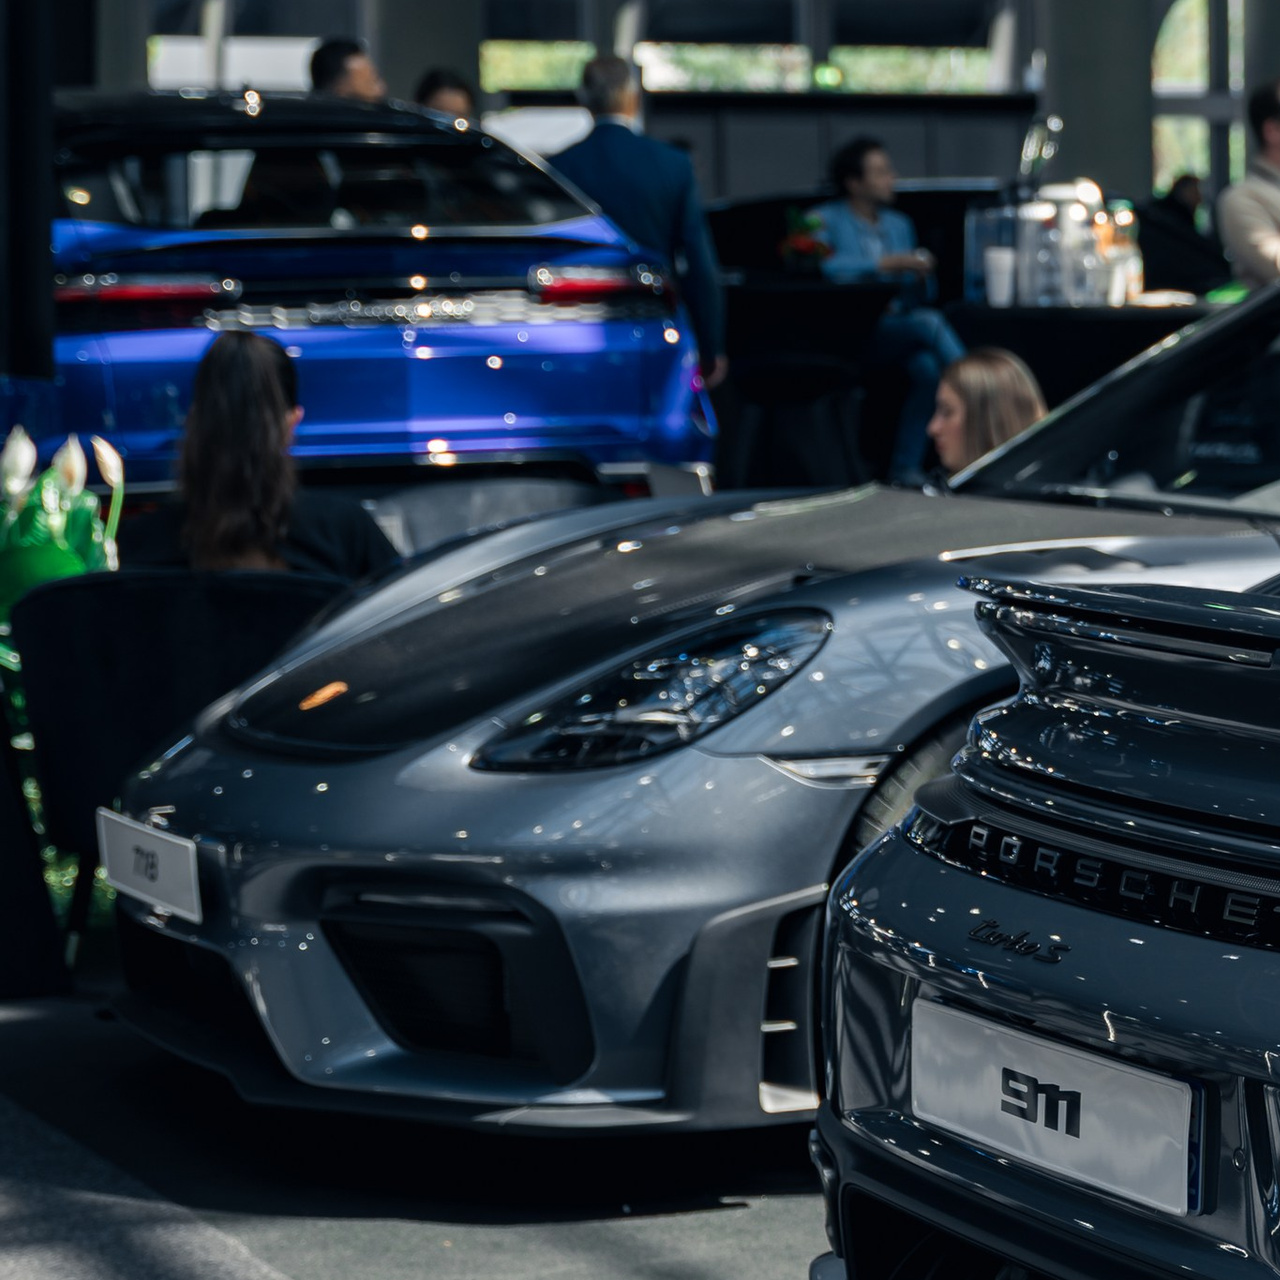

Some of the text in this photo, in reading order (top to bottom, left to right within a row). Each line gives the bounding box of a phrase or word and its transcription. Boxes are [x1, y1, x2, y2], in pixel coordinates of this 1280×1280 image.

[969, 825, 1262, 926] PORSCHE
[1033, 942, 1073, 964] S
[1001, 1066, 1081, 1139] 911
